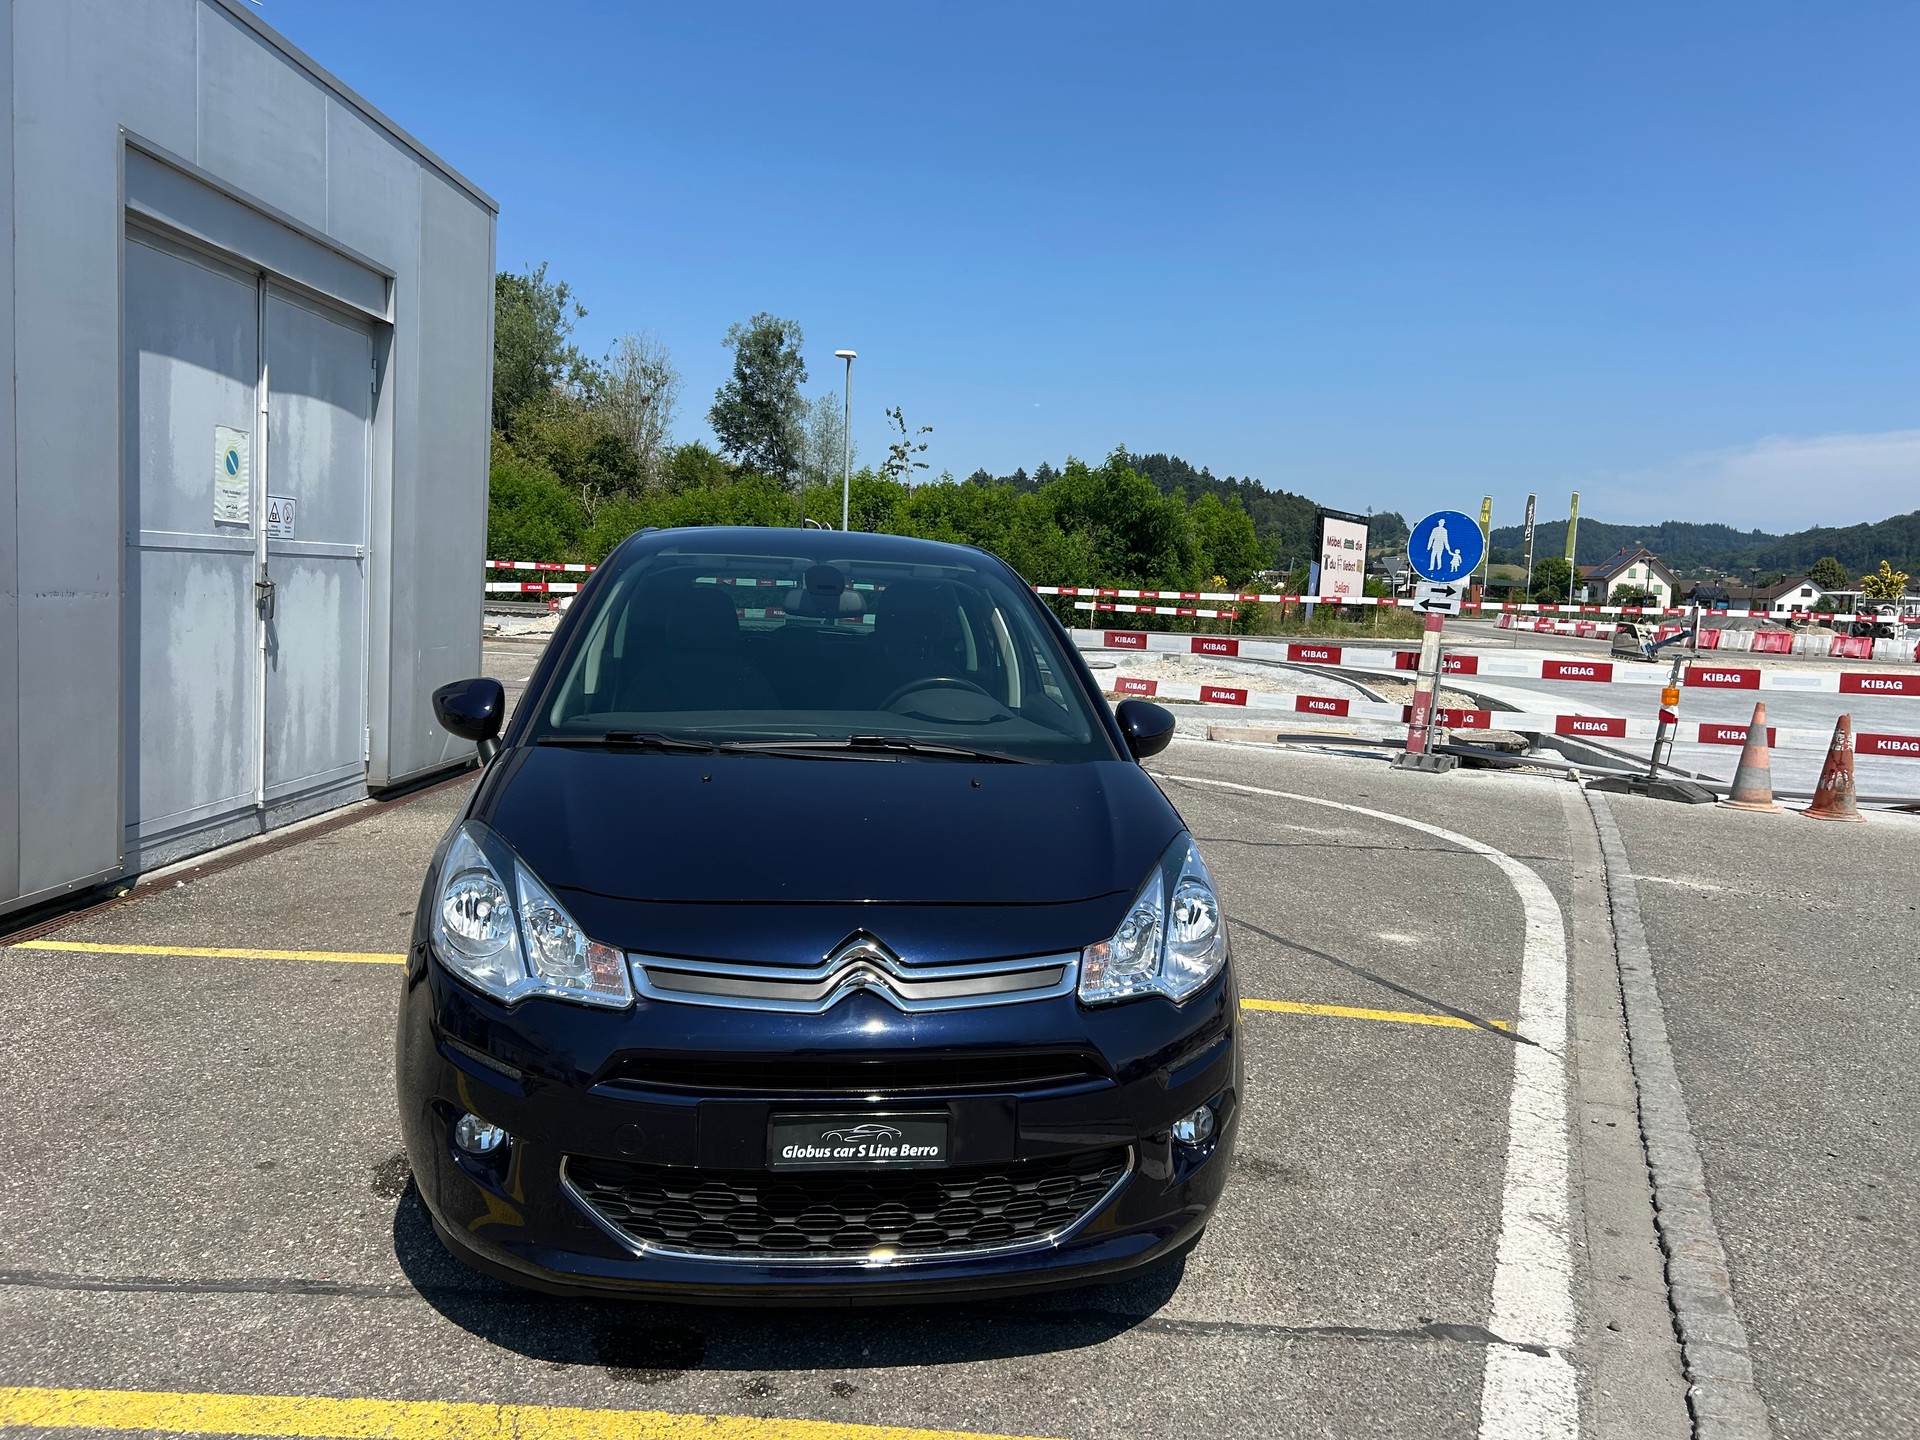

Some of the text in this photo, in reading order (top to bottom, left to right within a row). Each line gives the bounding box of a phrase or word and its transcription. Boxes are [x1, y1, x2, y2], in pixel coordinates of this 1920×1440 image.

[1327, 536, 1363, 551] Möbel, die
[1329, 558, 1356, 572] du liebst
[1114, 635, 1137, 645] KIBAG
[1202, 642, 1227, 652] KIBAG
[1300, 649, 1328, 659] KIBAG
[1559, 666, 1595, 676] KIBAG
[1702, 672, 1741, 683] KIBAG
[1124, 681, 1147, 692] KIBAG
[1860, 679, 1903, 690] KIBAG
[1211, 690, 1236, 700] KIBAG
[1308, 700, 1336, 711] KIBAG
[1572, 721, 1608, 732] KIBAG
[1717, 729, 1747, 740] KIBA
[1877, 740, 1920, 752] KIBAG
[782, 1143, 939, 1159] Globus car S Line Berro
